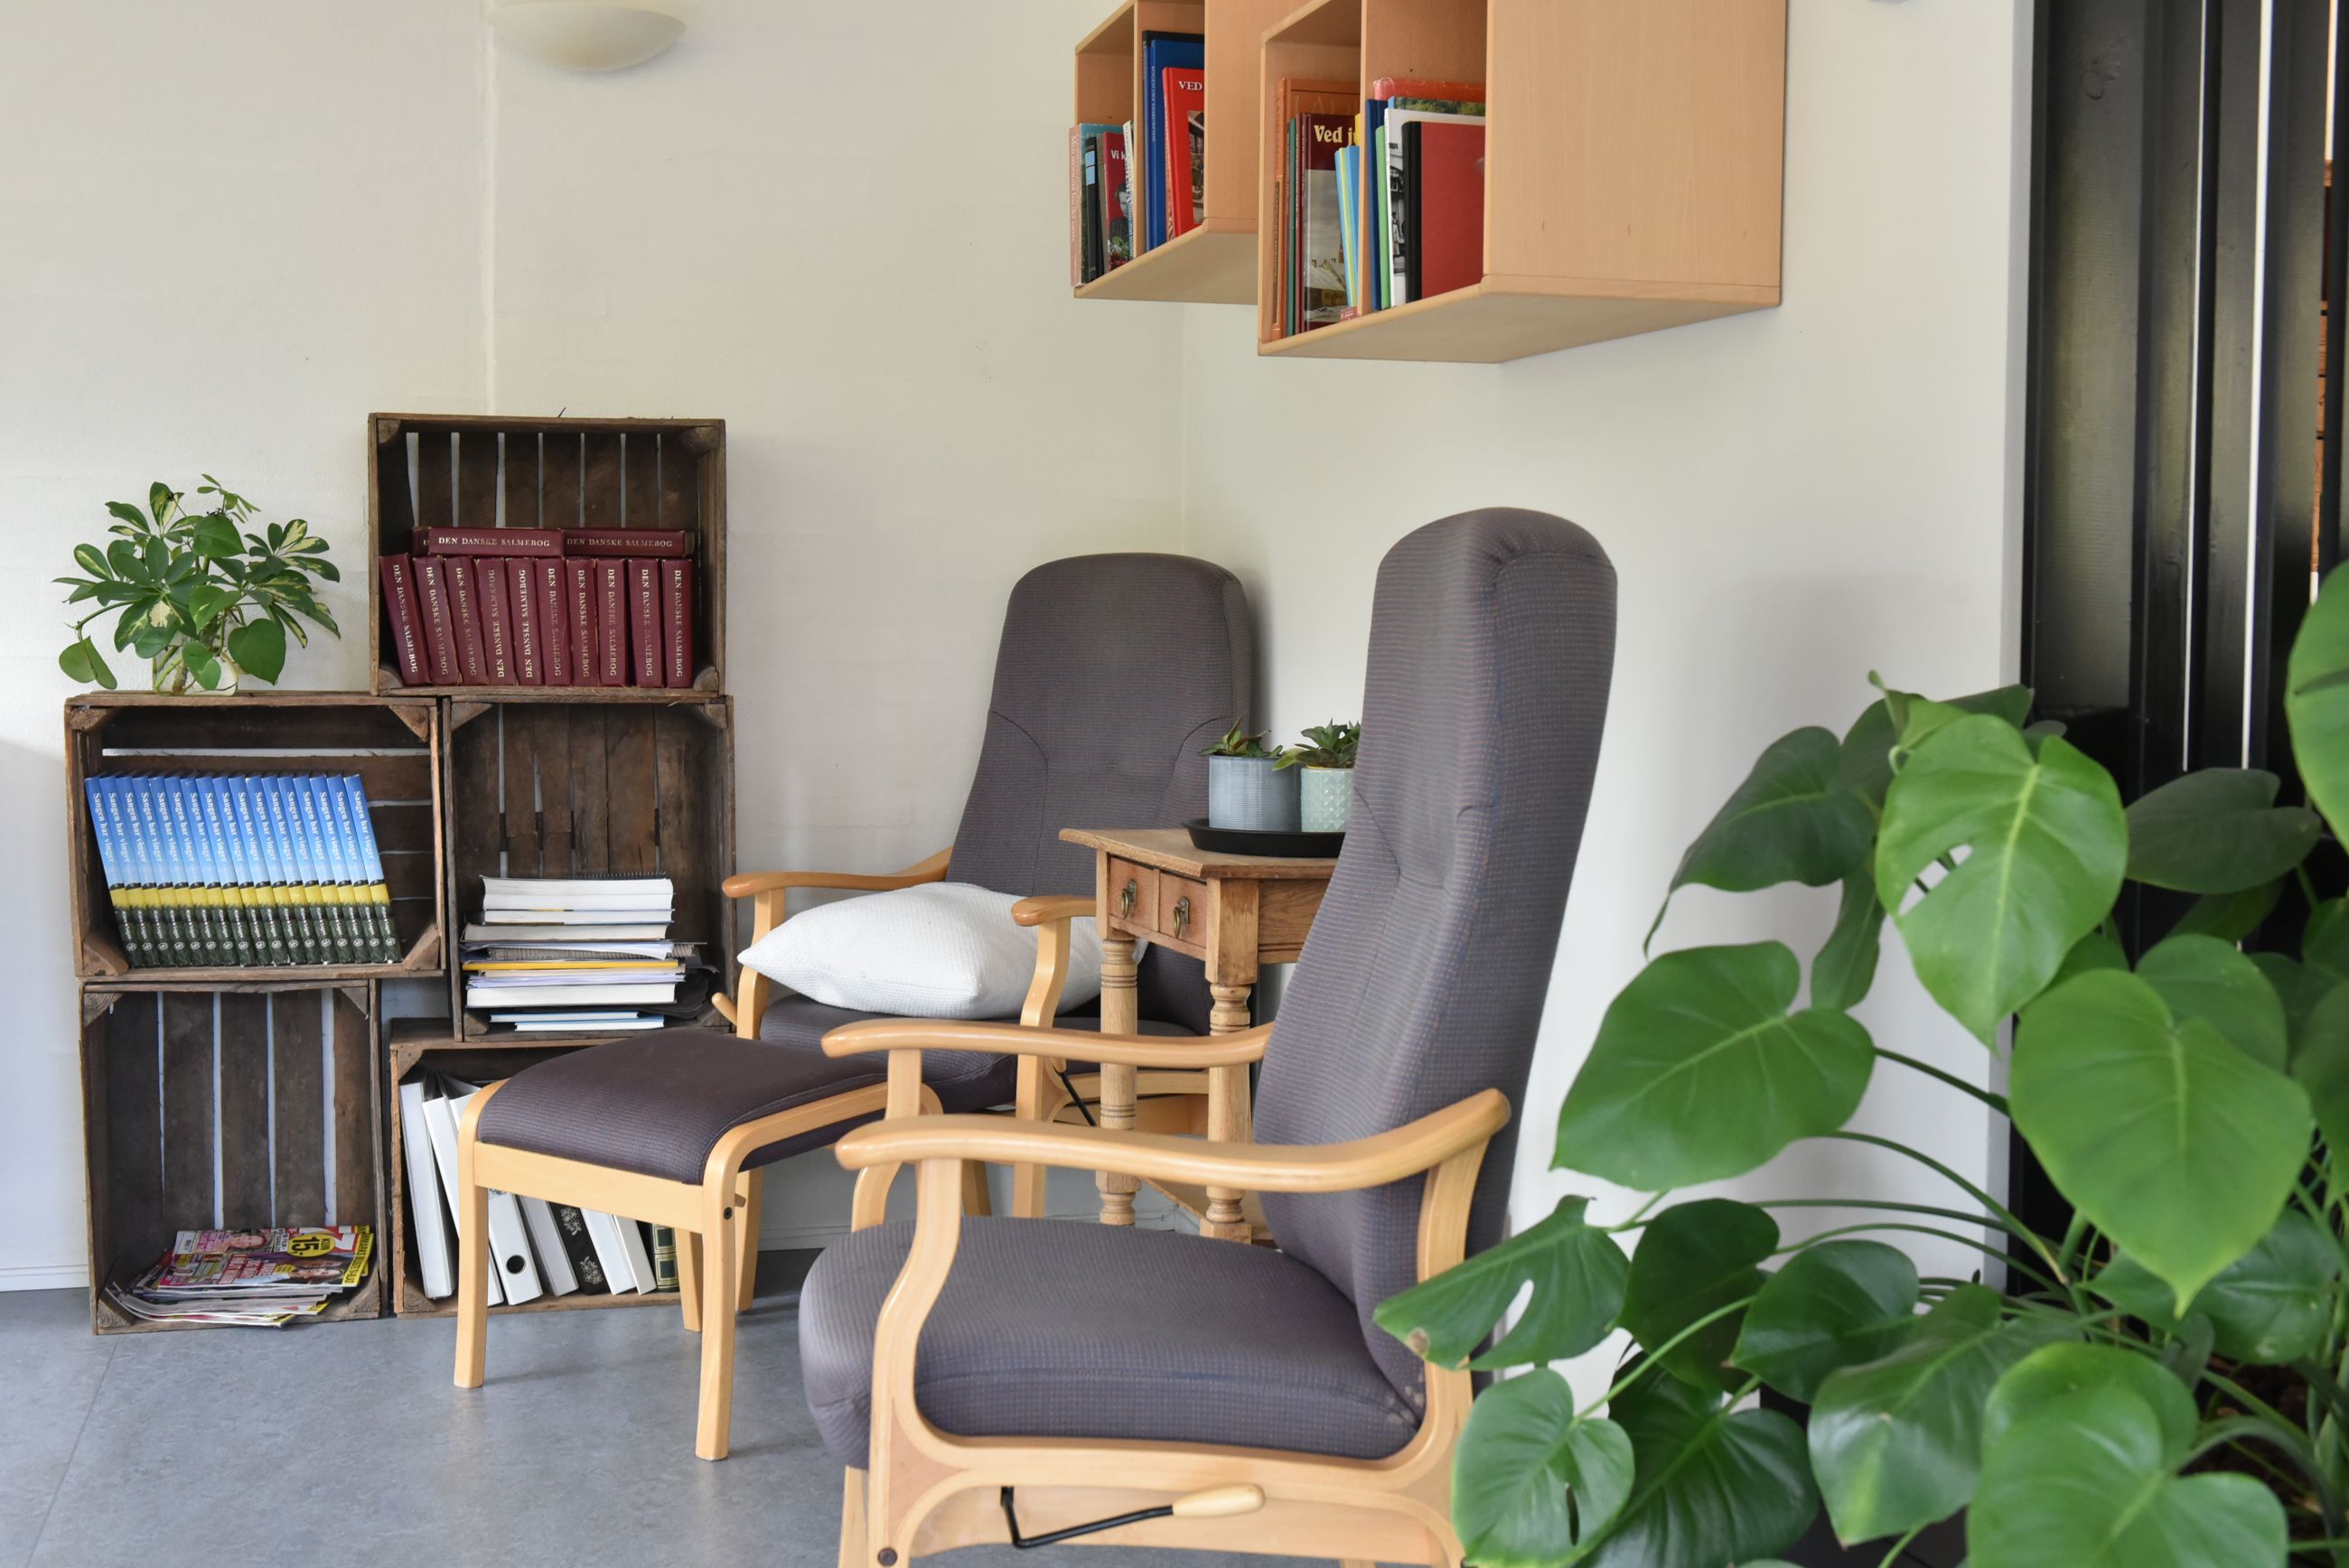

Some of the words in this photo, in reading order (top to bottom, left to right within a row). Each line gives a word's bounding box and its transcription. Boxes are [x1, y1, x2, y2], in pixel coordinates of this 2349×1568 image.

[1178, 80, 1203, 90] VED
[1314, 125, 1343, 144] Ved
[1110, 149, 1119, 160] Vi
[438, 537, 458, 545] DEN
[462, 537, 497, 546] DANSKE
[426, 566, 435, 585] DEN
[455, 567, 465, 586] DEN
[547, 567, 557, 587] DEN
[578, 570, 586, 589] DEN
[607, 569, 615, 588] DEN
[641, 569, 650, 588] DEN
[674, 570, 682, 588] DEN
[429, 589, 441, 624] DANSKE
[459, 590, 471, 625] DANSKE
[519, 569, 529, 617] SALMEBOG
[393, 565, 402, 583] DEN
[404, 624, 418, 673] SALMEBOG
[578, 593, 587, 627] DANSKE
[642, 592, 650, 626] DANSKE
[492, 621, 503, 655] DANSKE
[522, 621, 531, 655] DANSKE
[675, 630, 683, 677] SALMEBOG
[496, 658, 505, 677] DEN
[524, 658, 533, 677] DEN
[158, 792, 169, 821] Sangen
[173, 792, 184, 821] Sangen
[354, 790, 365, 819] Sangen
[93, 793, 105, 821] Sangen
[100, 823, 108, 836] har
[105, 838, 115, 862] vinger
[108, 793, 120, 821] Sangen
[116, 823, 124, 836] har
[120, 838, 130, 862] vinger
[126, 793, 136, 821] Sangen
[132, 822, 140, 836] har
[136, 837, 146, 862] vinger
[142, 792, 153, 821] Sangen
[148, 822, 156, 836] har
[153, 837, 163, 862] vinger
[164, 822, 173, 836] har
[181, 822, 189, 836] har
[191, 792, 201, 821] Sangen
[197, 822, 205, 835] har
[201, 837, 211, 862] vinger
[206, 792, 217, 821] Sangen
[212, 822, 220, 835] har
[217, 837, 227, 862] vinger
[222, 792, 233, 821] Sangen
[229, 822, 237, 835] har
[233, 837, 243, 861] vinger
[239, 792, 249, 821] Sangen
[245, 821, 253, 835] har
[249, 836, 259, 861] vinger
[256, 792, 267, 820] Sangen
[262, 821, 270, 835] har
[267, 836, 276, 861] vinger
[272, 792, 282, 820] Sangen
[278, 821, 286, 835] har
[282, 836, 292, 861] vinger
[287, 791, 298, 820] Sangen
[294, 820, 302, 835] har
[298, 835, 308, 861] vinger
[304, 791, 314, 820] Sangen
[310, 820, 318, 835] har
[314, 835, 324, 861] vinger
[320, 791, 331, 820] Sangen
[331, 835, 341, 861] vinger
[336, 791, 348, 820] Sangen
[347, 835, 357, 861] vinger
[360, 820, 369, 834] har
[168, 837, 178, 862] vinger
[184, 837, 194, 862] vinger
[364, 835, 374, 859] vinger
[321, 1238, 332, 1251] KUN
